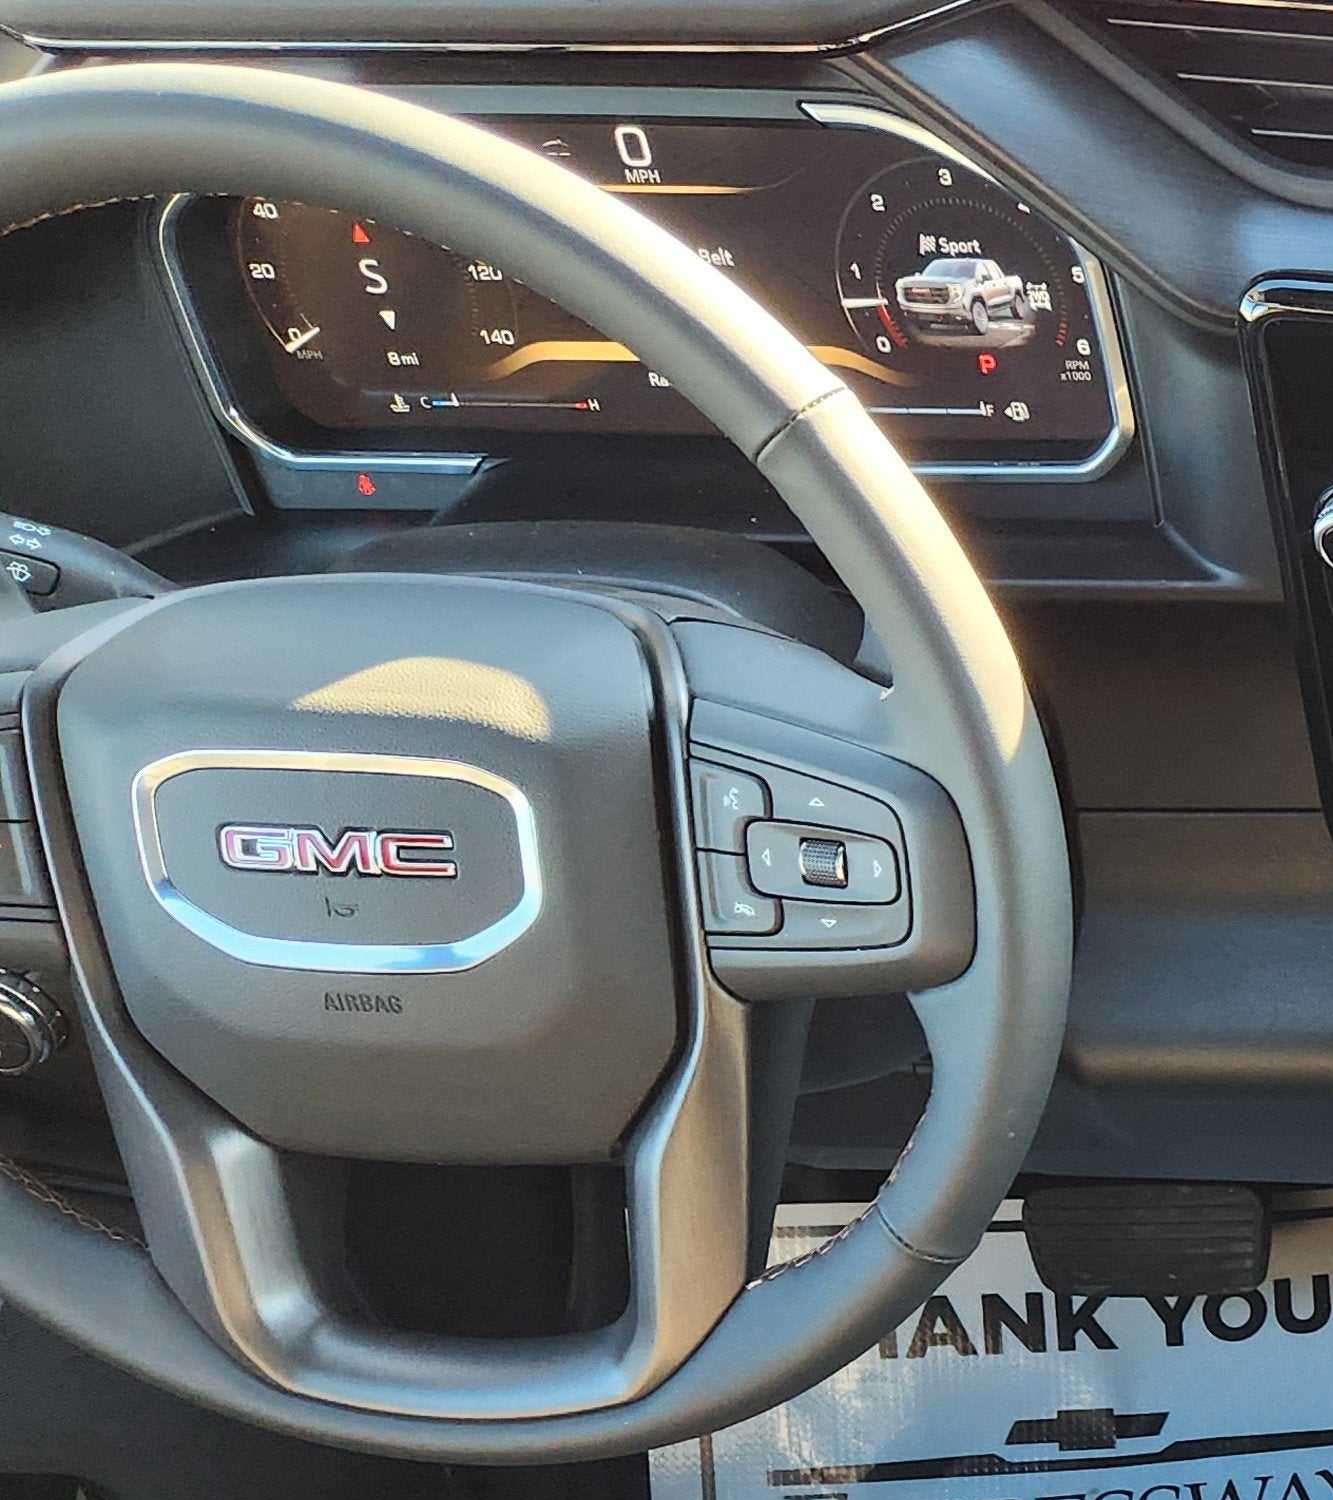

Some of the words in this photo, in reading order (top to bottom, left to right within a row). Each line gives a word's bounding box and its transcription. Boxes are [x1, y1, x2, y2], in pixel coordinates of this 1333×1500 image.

[614, 125, 651, 167] 0
[624, 169, 661, 184] MPH
[938, 168, 952, 186] 3
[253, 203, 278, 219] 40
[870, 194, 886, 211] 2
[938, 237, 982, 257] Sport
[698, 247, 735, 267] Belt
[249, 263, 275, 280] 20
[358, 259, 388, 294] S
[468, 264, 502, 281] 120
[850, 262, 862, 280] 1
[1071, 266, 1085, 284] 5
[480, 329, 515, 345] 140
[876, 335, 891, 353] 0
[1077, 338, 1091, 356] 6
[978, 353, 997, 375] P
[1065, 359, 1090, 371] RPM
[1060, 371, 1092, 382] x1000
[420, 395, 432, 409] C
[587, 398, 601, 411] H
[216, 822, 458, 879] GMC
[324, 990, 403, 1015] AIRBAG
[879, 1291, 1119, 1360] ANK
